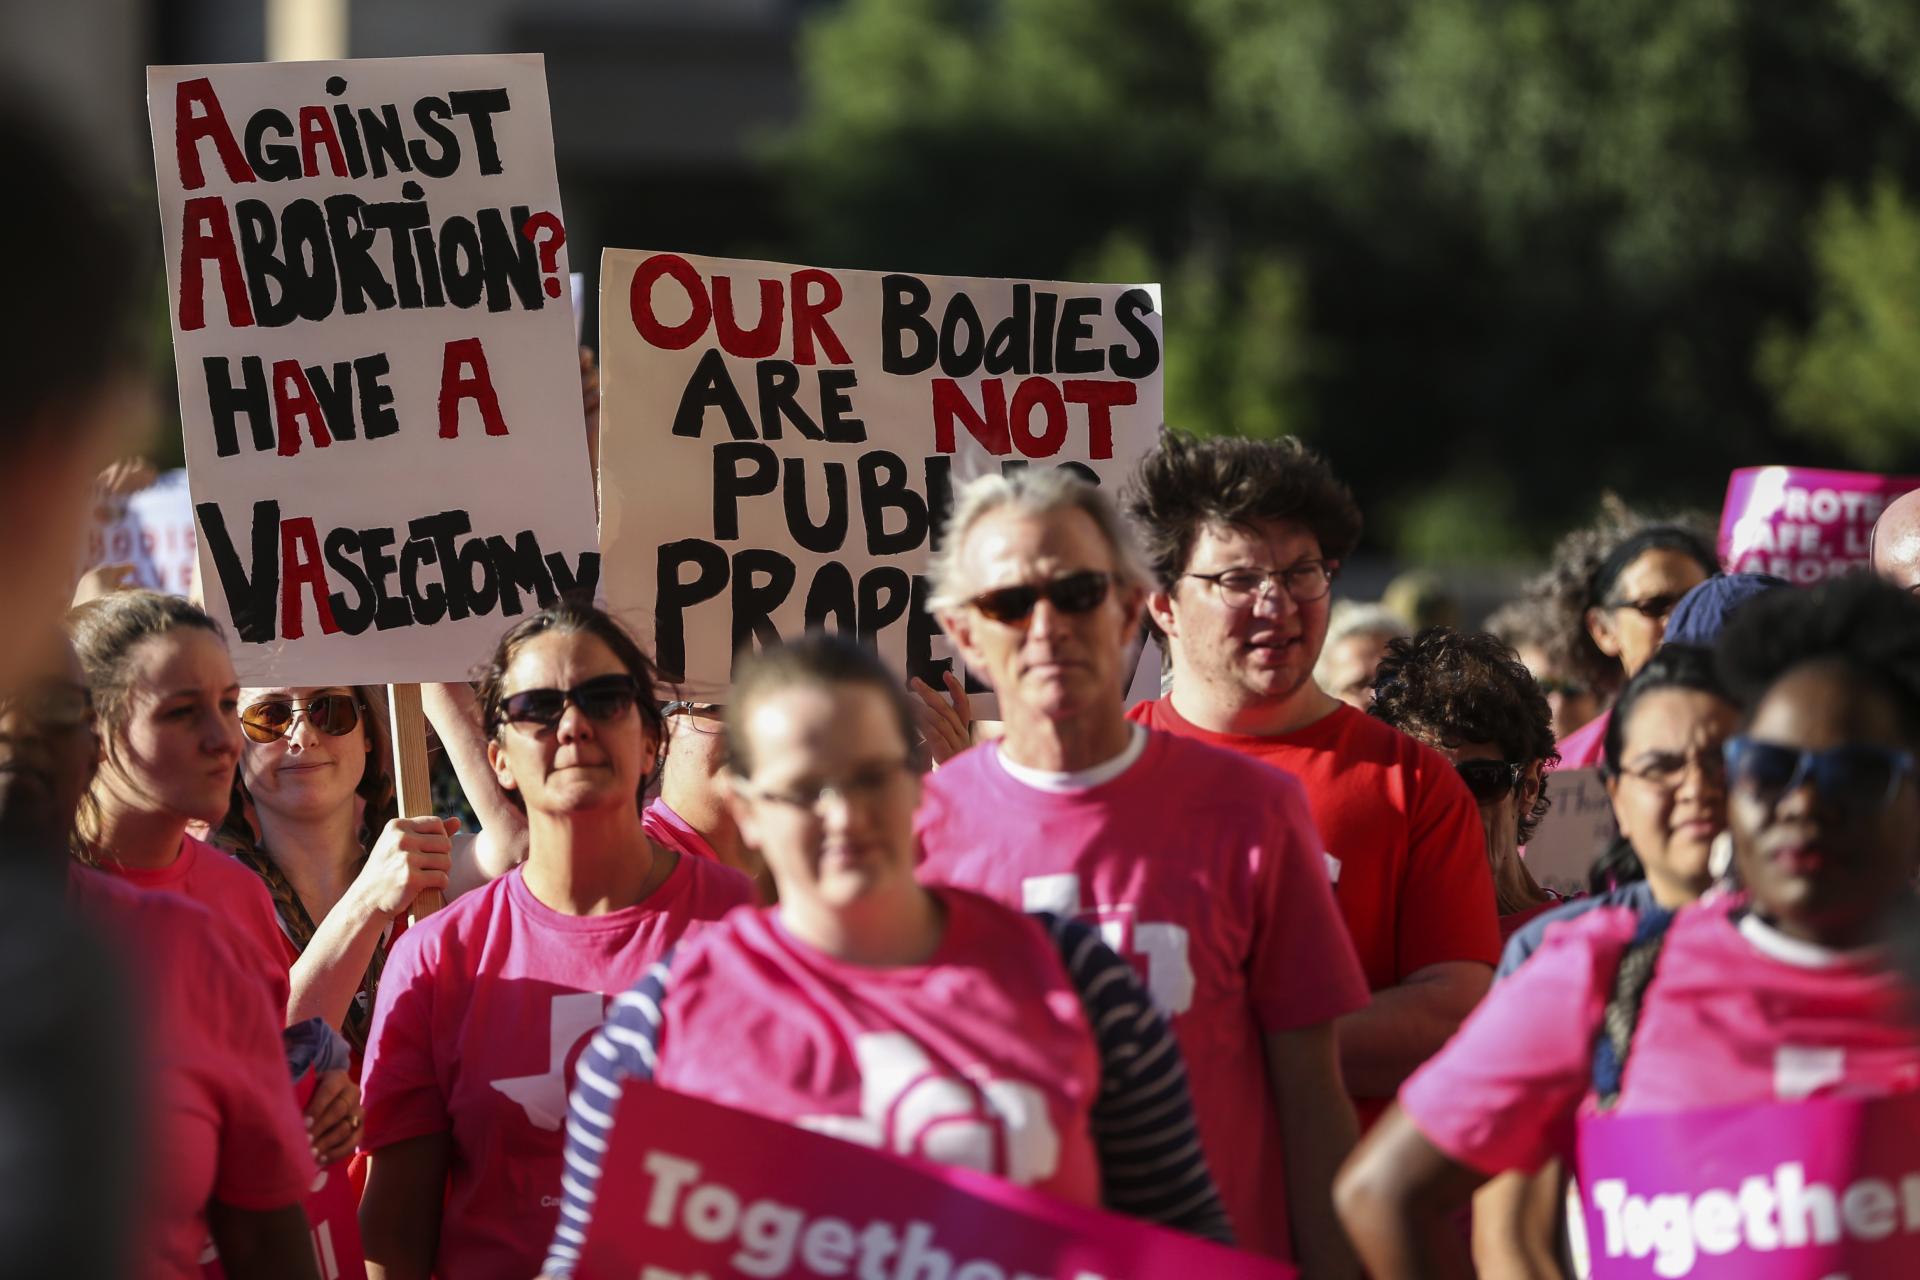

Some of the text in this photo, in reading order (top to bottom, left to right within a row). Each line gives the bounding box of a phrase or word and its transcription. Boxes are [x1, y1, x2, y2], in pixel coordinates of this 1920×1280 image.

[630, 253, 854, 365] OUR
[203, 337, 509, 457] HAVE A
[671, 348, 1138, 459] ARE NOT
[713, 442, 1102, 556] PUBL
[196, 500, 600, 643] VASECTOMY
[655, 537, 1148, 700] PROPE
[643, 1151, 1052, 1280] Togeth
